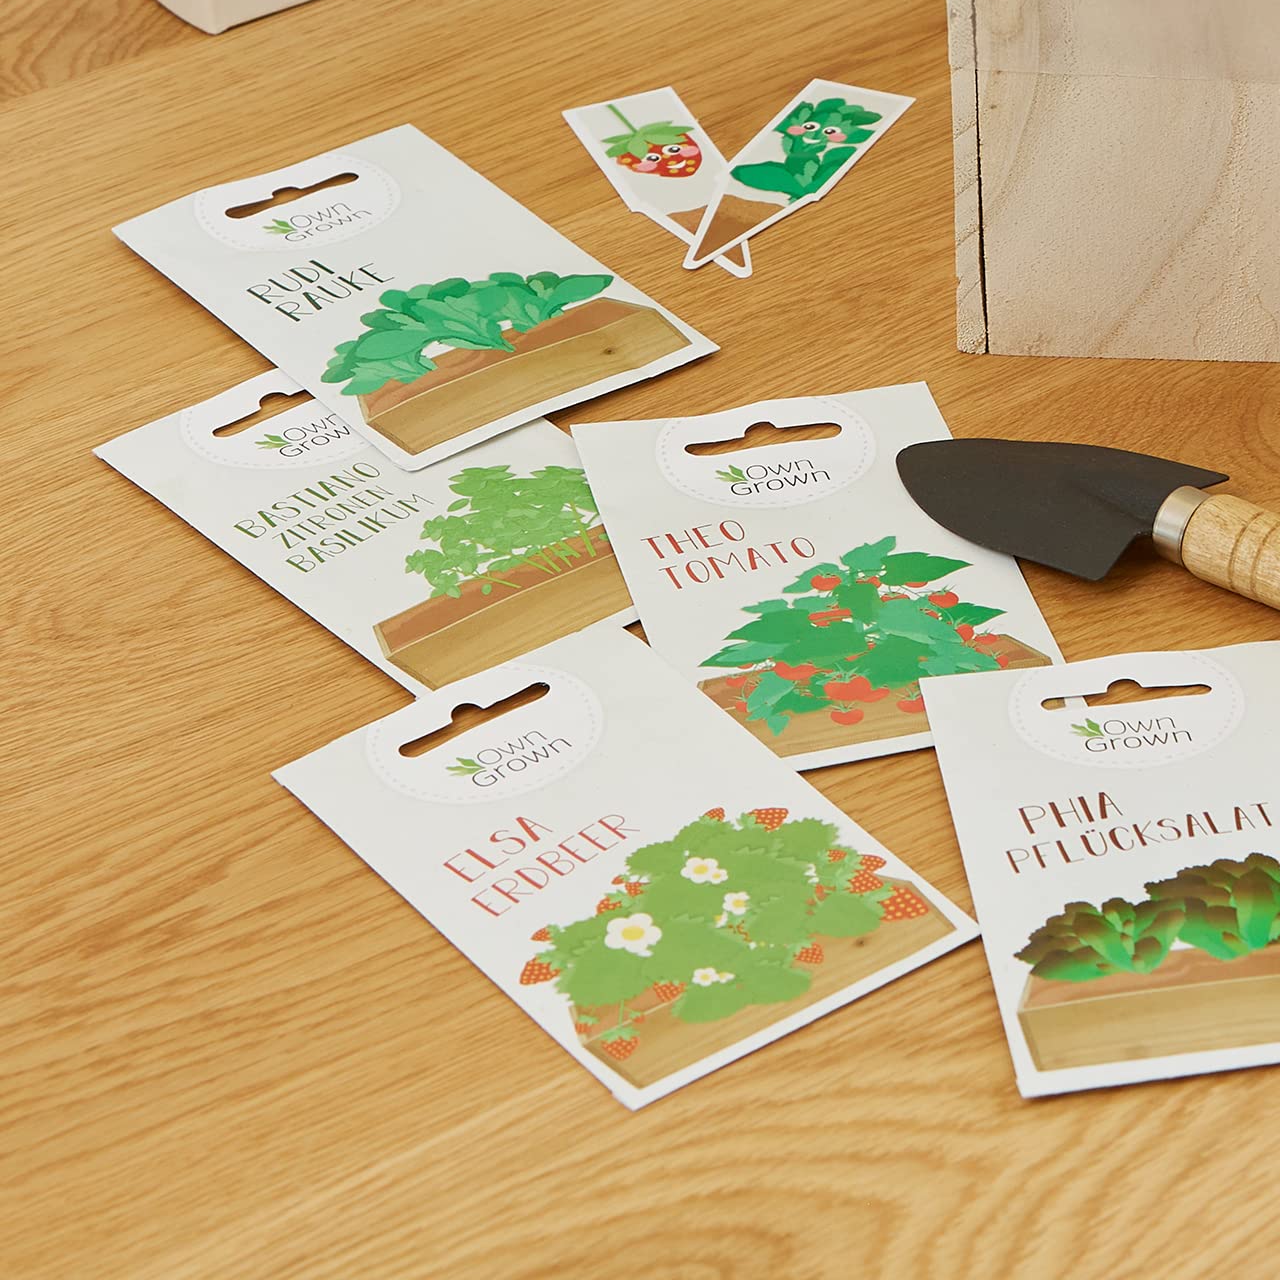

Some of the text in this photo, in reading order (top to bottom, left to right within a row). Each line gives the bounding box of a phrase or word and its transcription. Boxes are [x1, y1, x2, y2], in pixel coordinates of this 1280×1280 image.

[285, 209, 373, 243] Grown
[290, 203, 351, 228] Own
[247, 259, 336, 306] RUDI
[275, 262, 396, 322] RAUKE
[279, 425, 350, 457] Grow
[730, 467, 831, 496] Grown
[745, 457, 815, 481] Own
[233, 461, 382, 542] BASTIANO
[271, 486, 395, 549] ZITRONEN
[285, 491, 435, 573] BASILIKUM
[640, 519, 746, 560] THEO
[657, 536, 817, 590] TOMATO
[475, 725, 548, 767] Own
[1085, 728, 1193, 753] Grown
[1102, 716, 1176, 736] Own
[471, 736, 573, 788] Grown
[1017, 791, 1124, 834] PHIA
[443, 816, 554, 885] ELSA
[1005, 802, 1276, 874] PFLÜCKSALAT
[470, 814, 641, 917] ERDBEER
